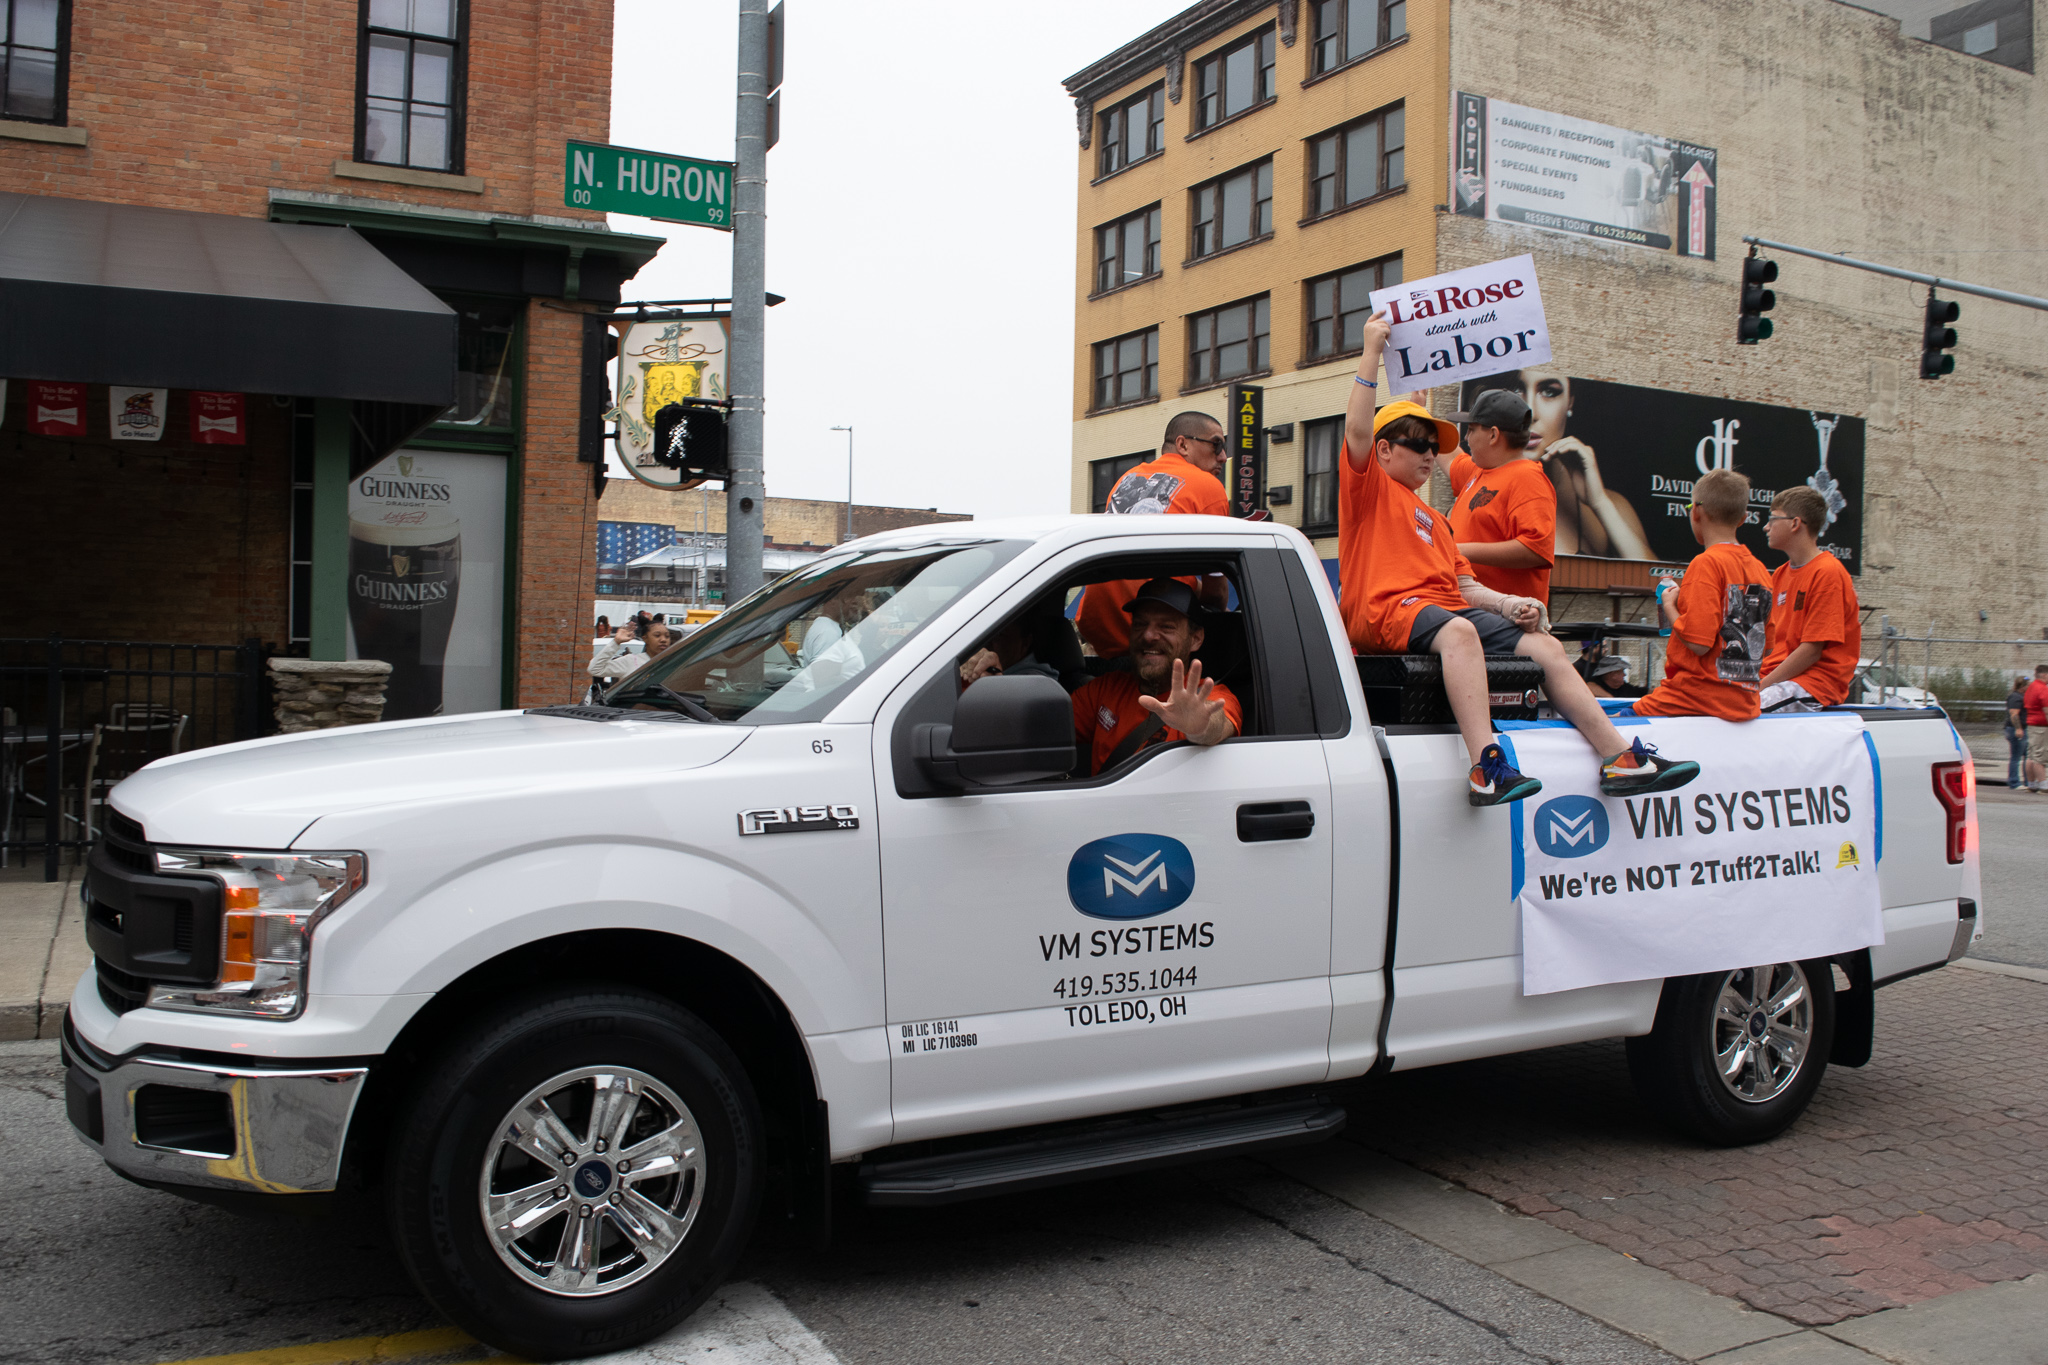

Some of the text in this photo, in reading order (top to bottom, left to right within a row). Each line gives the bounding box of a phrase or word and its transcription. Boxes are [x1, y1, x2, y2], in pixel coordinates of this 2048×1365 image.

[1467, 101, 1477, 160] LOFT
[1501, 117, 1552, 135] BANQUETS
[1558, 129, 1615, 149] RECEPTIONS
[1501, 138, 1611, 169] CORPORATE FUNCTIONS
[573, 150, 725, 205] N. HURON
[1501, 159, 1578, 182] SPECIAL EVENTS
[573, 189, 592, 205] 00
[1501, 180, 1565, 200] FUNDRAISERS
[708, 208, 724, 222] 99
[1525, 211, 1561, 227] RESERVE
[1563, 218, 1591, 233] TODAY
[1386, 278, 1524, 326] LaRose
[1425, 310, 1497, 336] stands with
[1395, 328, 1536, 378] Labor
[1240, 391, 1256, 449] TABLE
[360, 476, 450, 501] GUINNESS
[1239, 455, 1254, 513] FORTY
[1651, 474, 1695, 495] DAVID
[385, 500, 425, 508] DRAUGHT
[1667, 502, 1688, 517] FIN
[1653, 568, 1685, 578] LAMA
[355, 574, 448, 601] GUINNESS
[379, 603, 424, 611] DRAUGHT
[811, 739, 833, 754] 65
[1625, 784, 1851, 840] VM SYSTEMS
[1540, 871, 1617, 900] We're
[1626, 864, 1681, 892] NOT
[1690, 850, 1821, 886] 2Tuff2Talk!
[1039, 922, 1215, 961] VM SYSTEMS
[1053, 966, 1198, 999] 419.535.1044
[1064, 995, 1187, 1027] TOLEDO, OH
[902, 1020, 959, 1038] OH LIC 16141
[903, 1033, 978, 1053] MI LIC 7103960
